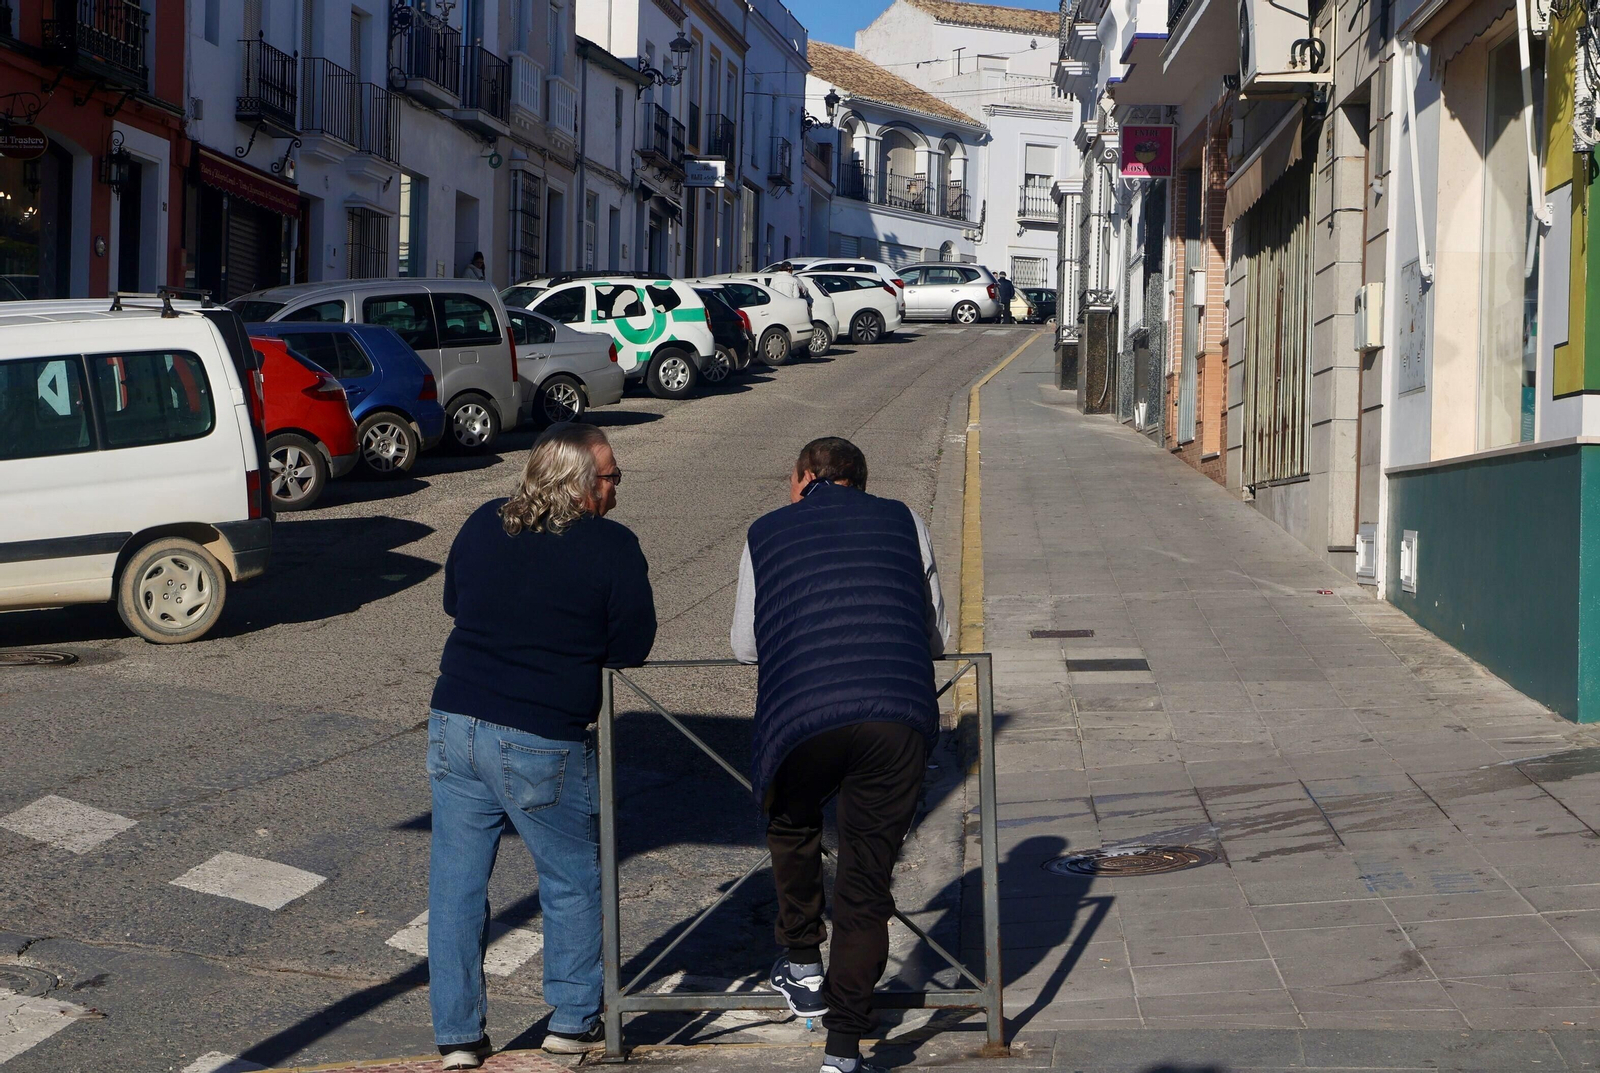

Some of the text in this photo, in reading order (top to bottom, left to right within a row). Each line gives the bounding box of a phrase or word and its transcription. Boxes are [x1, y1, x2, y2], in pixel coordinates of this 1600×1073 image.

[1135, 129, 1159, 137] ENTRE
[9, 136, 44, 144] Trastero
[1125, 165, 1167, 173] COSTURAS
